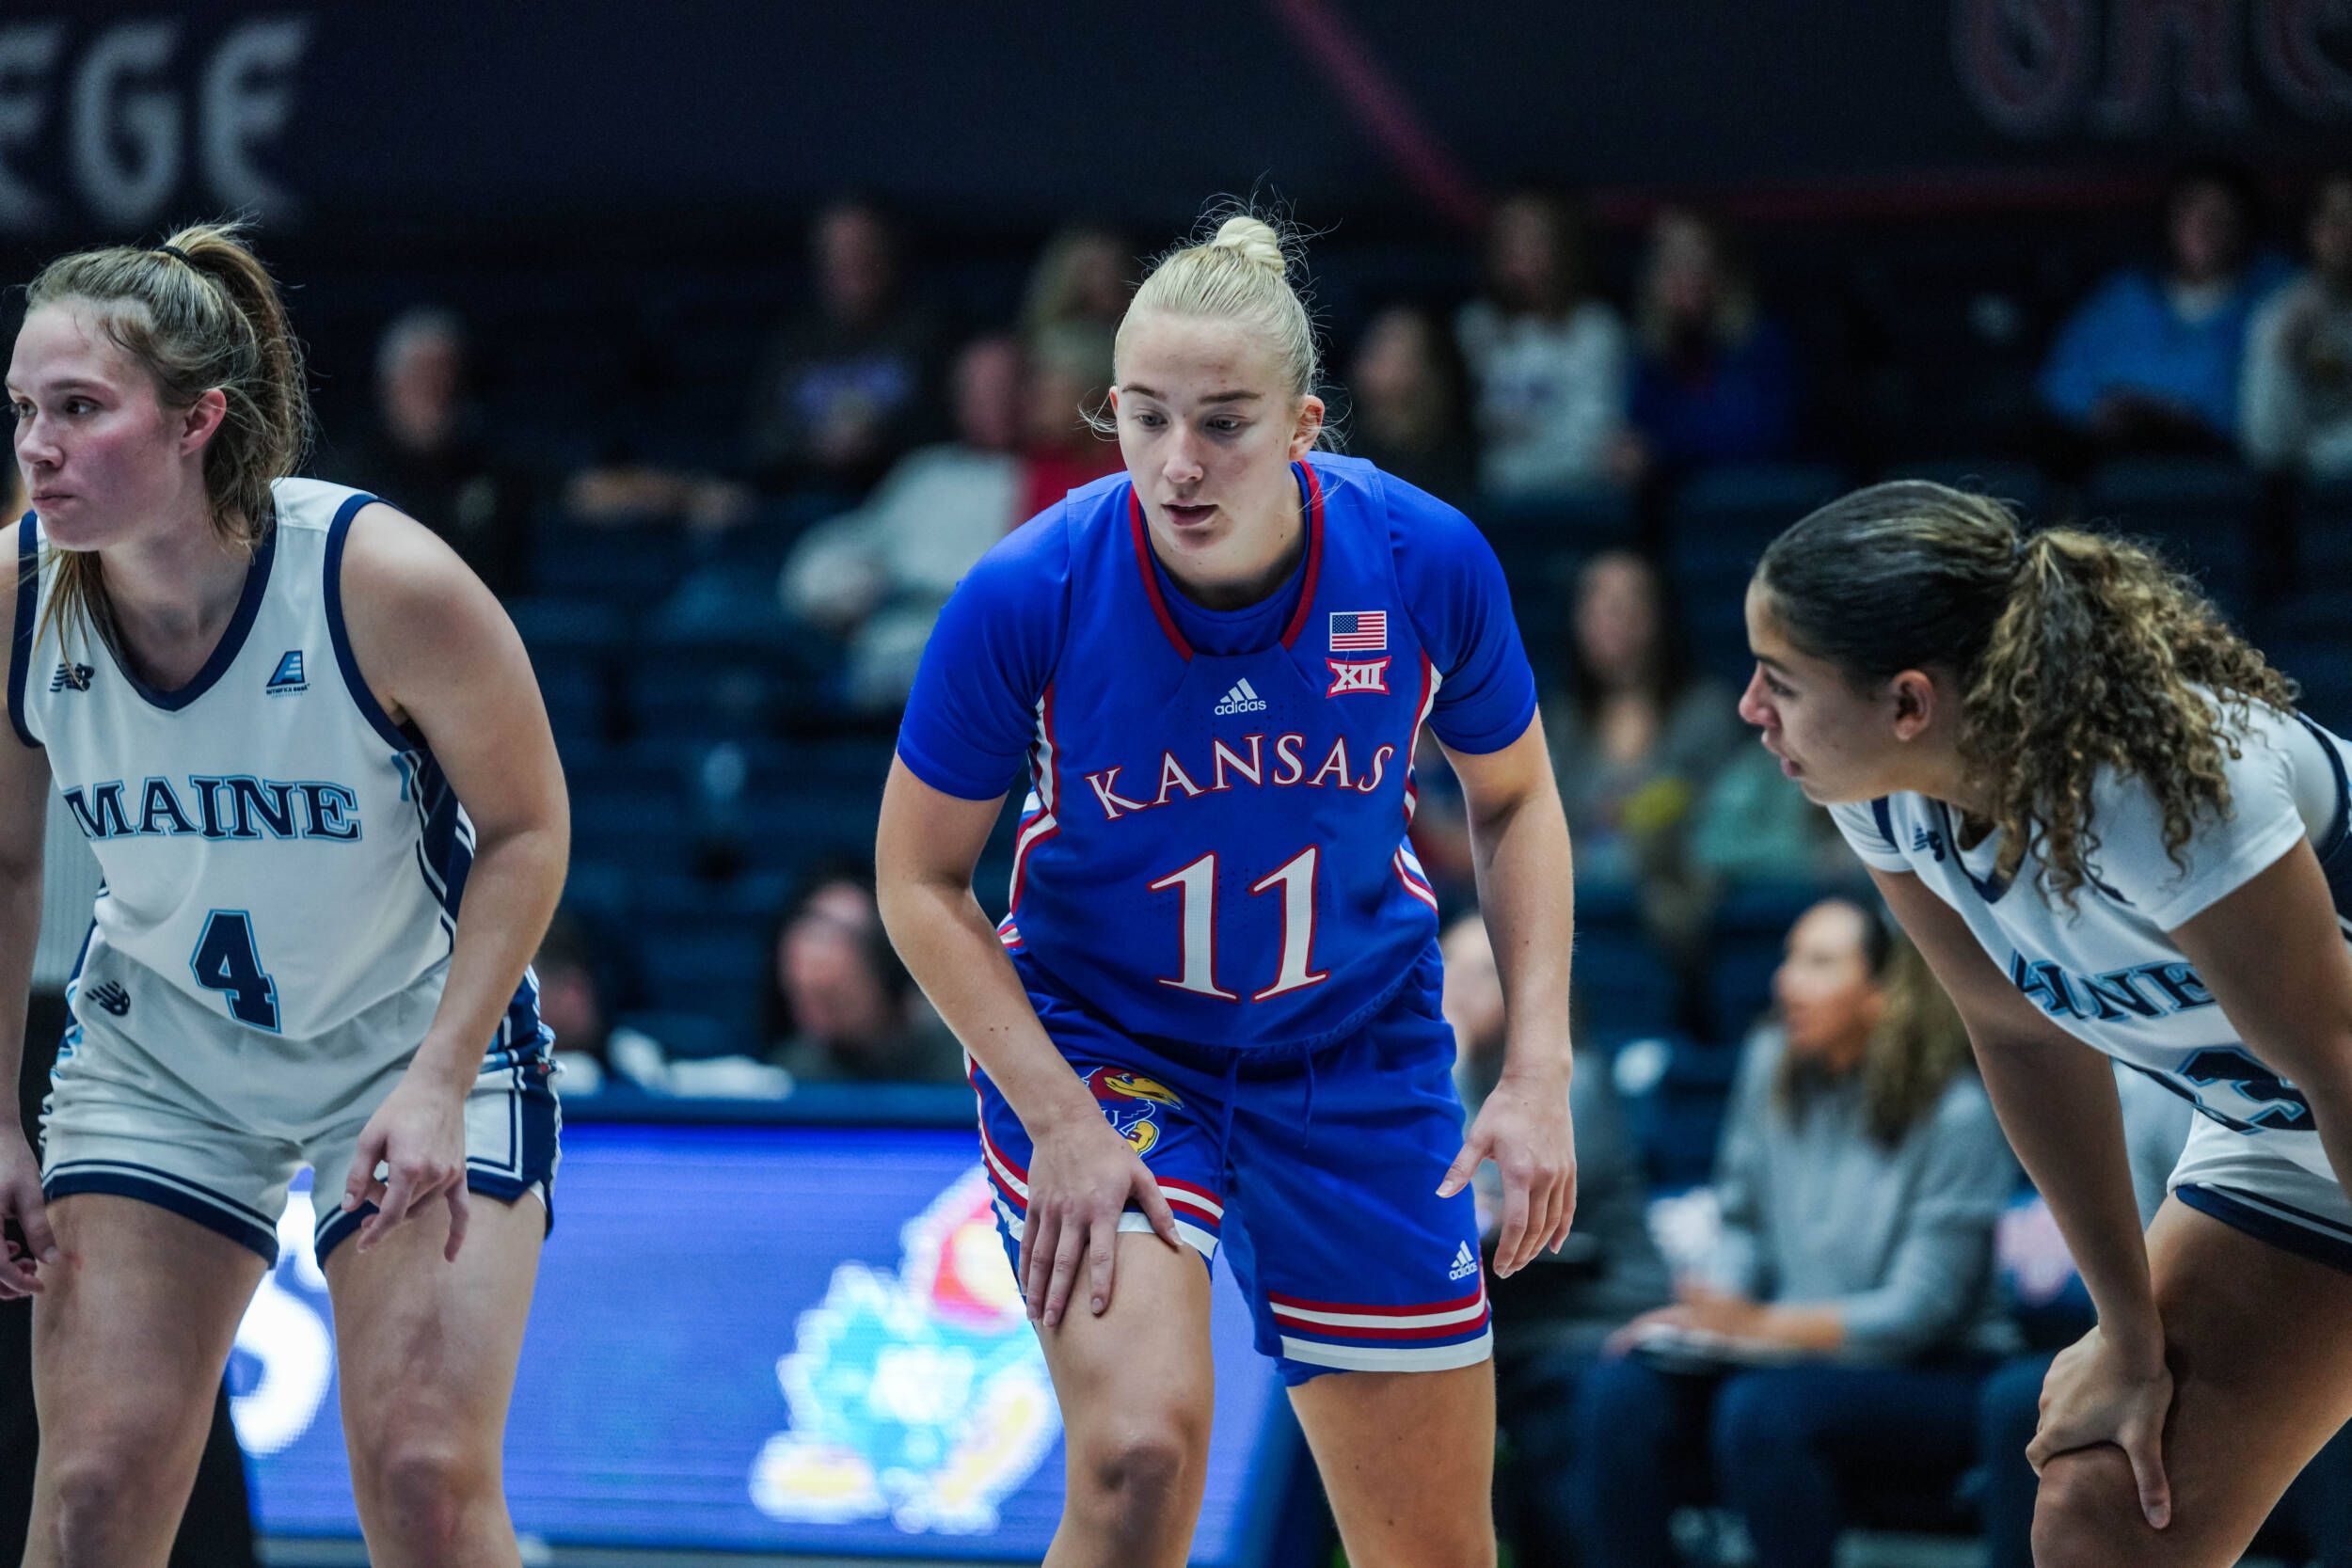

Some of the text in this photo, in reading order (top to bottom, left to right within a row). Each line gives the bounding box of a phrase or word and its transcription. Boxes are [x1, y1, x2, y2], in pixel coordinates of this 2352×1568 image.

[1214, 699, 1267, 716] adidas
[1328, 658, 1389, 695] XII
[61, 774, 363, 841] MAINE
[1085, 733, 1395, 821] KANSAS
[1147, 843, 1330, 1005] 11
[188, 908, 282, 1035] 4
[1449, 1261, 1478, 1281] adidas
